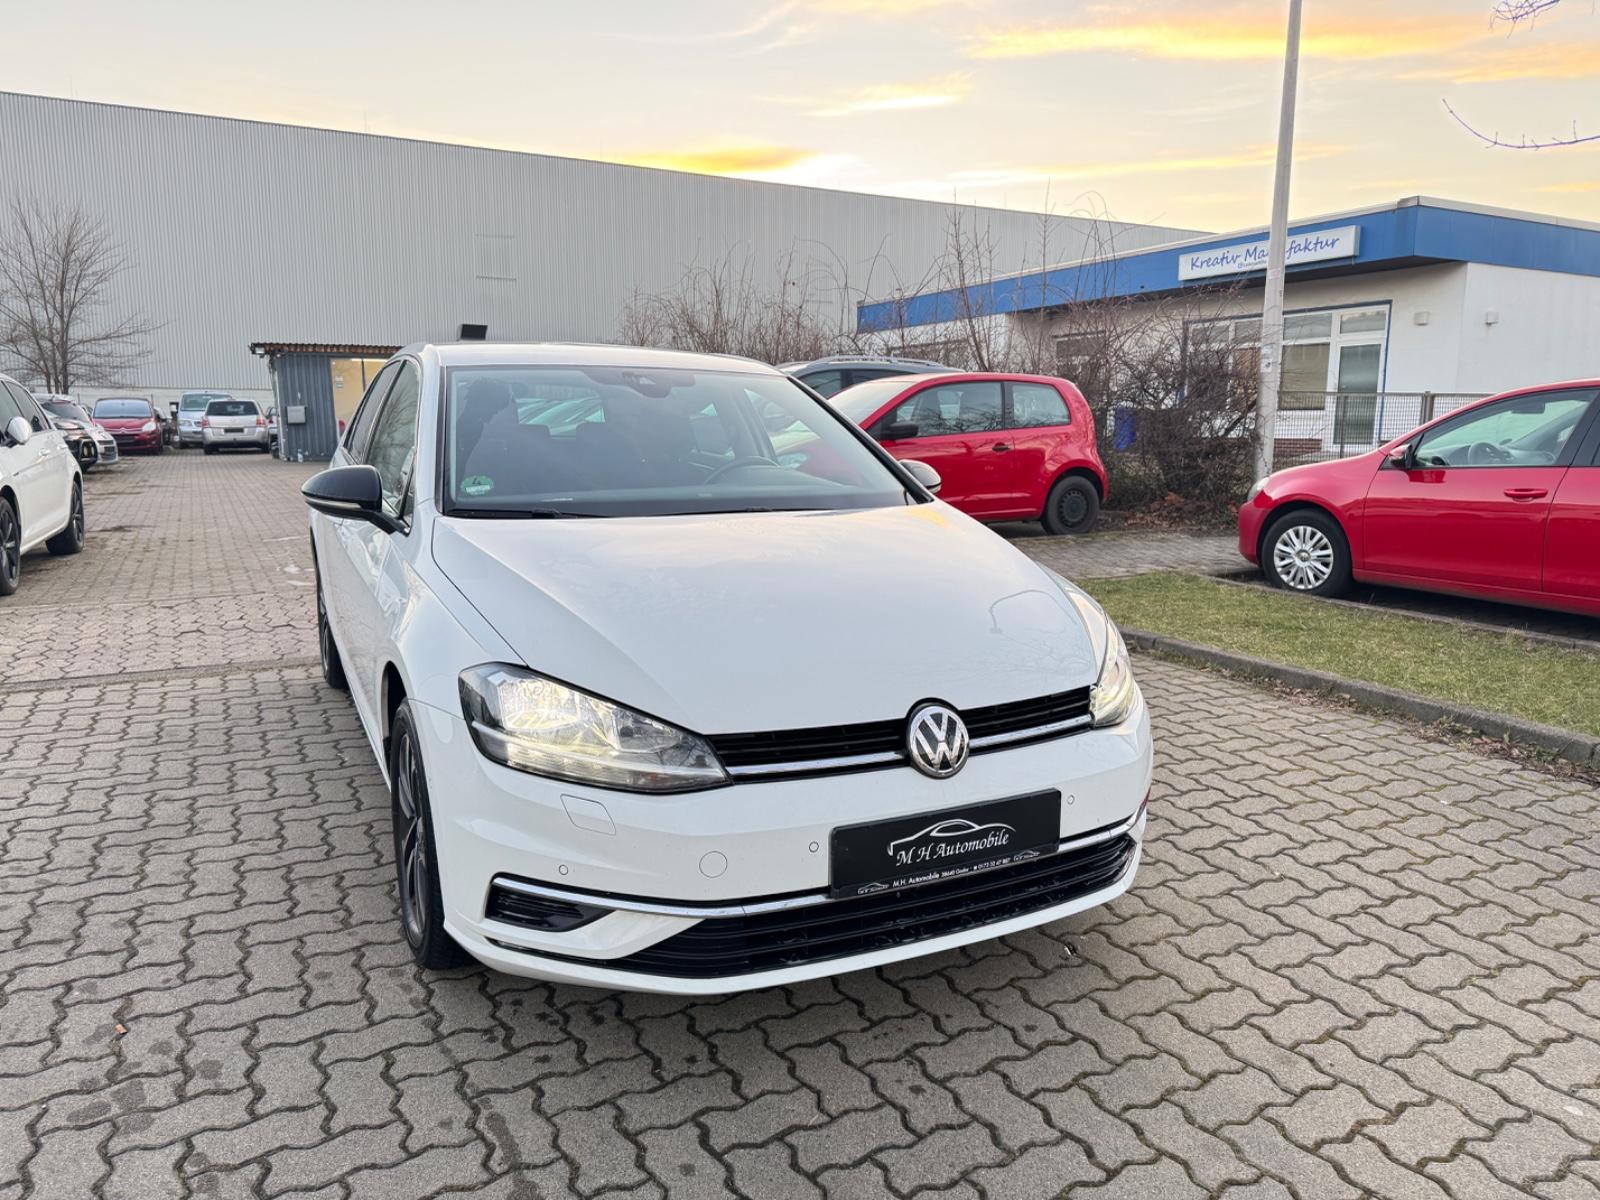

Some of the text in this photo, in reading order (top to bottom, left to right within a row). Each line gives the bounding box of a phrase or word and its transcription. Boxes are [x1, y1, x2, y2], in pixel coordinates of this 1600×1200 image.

[1190, 236, 1340, 270] Kreativ Mafaktur
[911, 709, 966, 774] VW
[896, 846, 914, 866] M
[916, 843, 934, 862] H
[933, 829, 1009, 858] Automobile
[909, 872, 940, 884] Automobile
